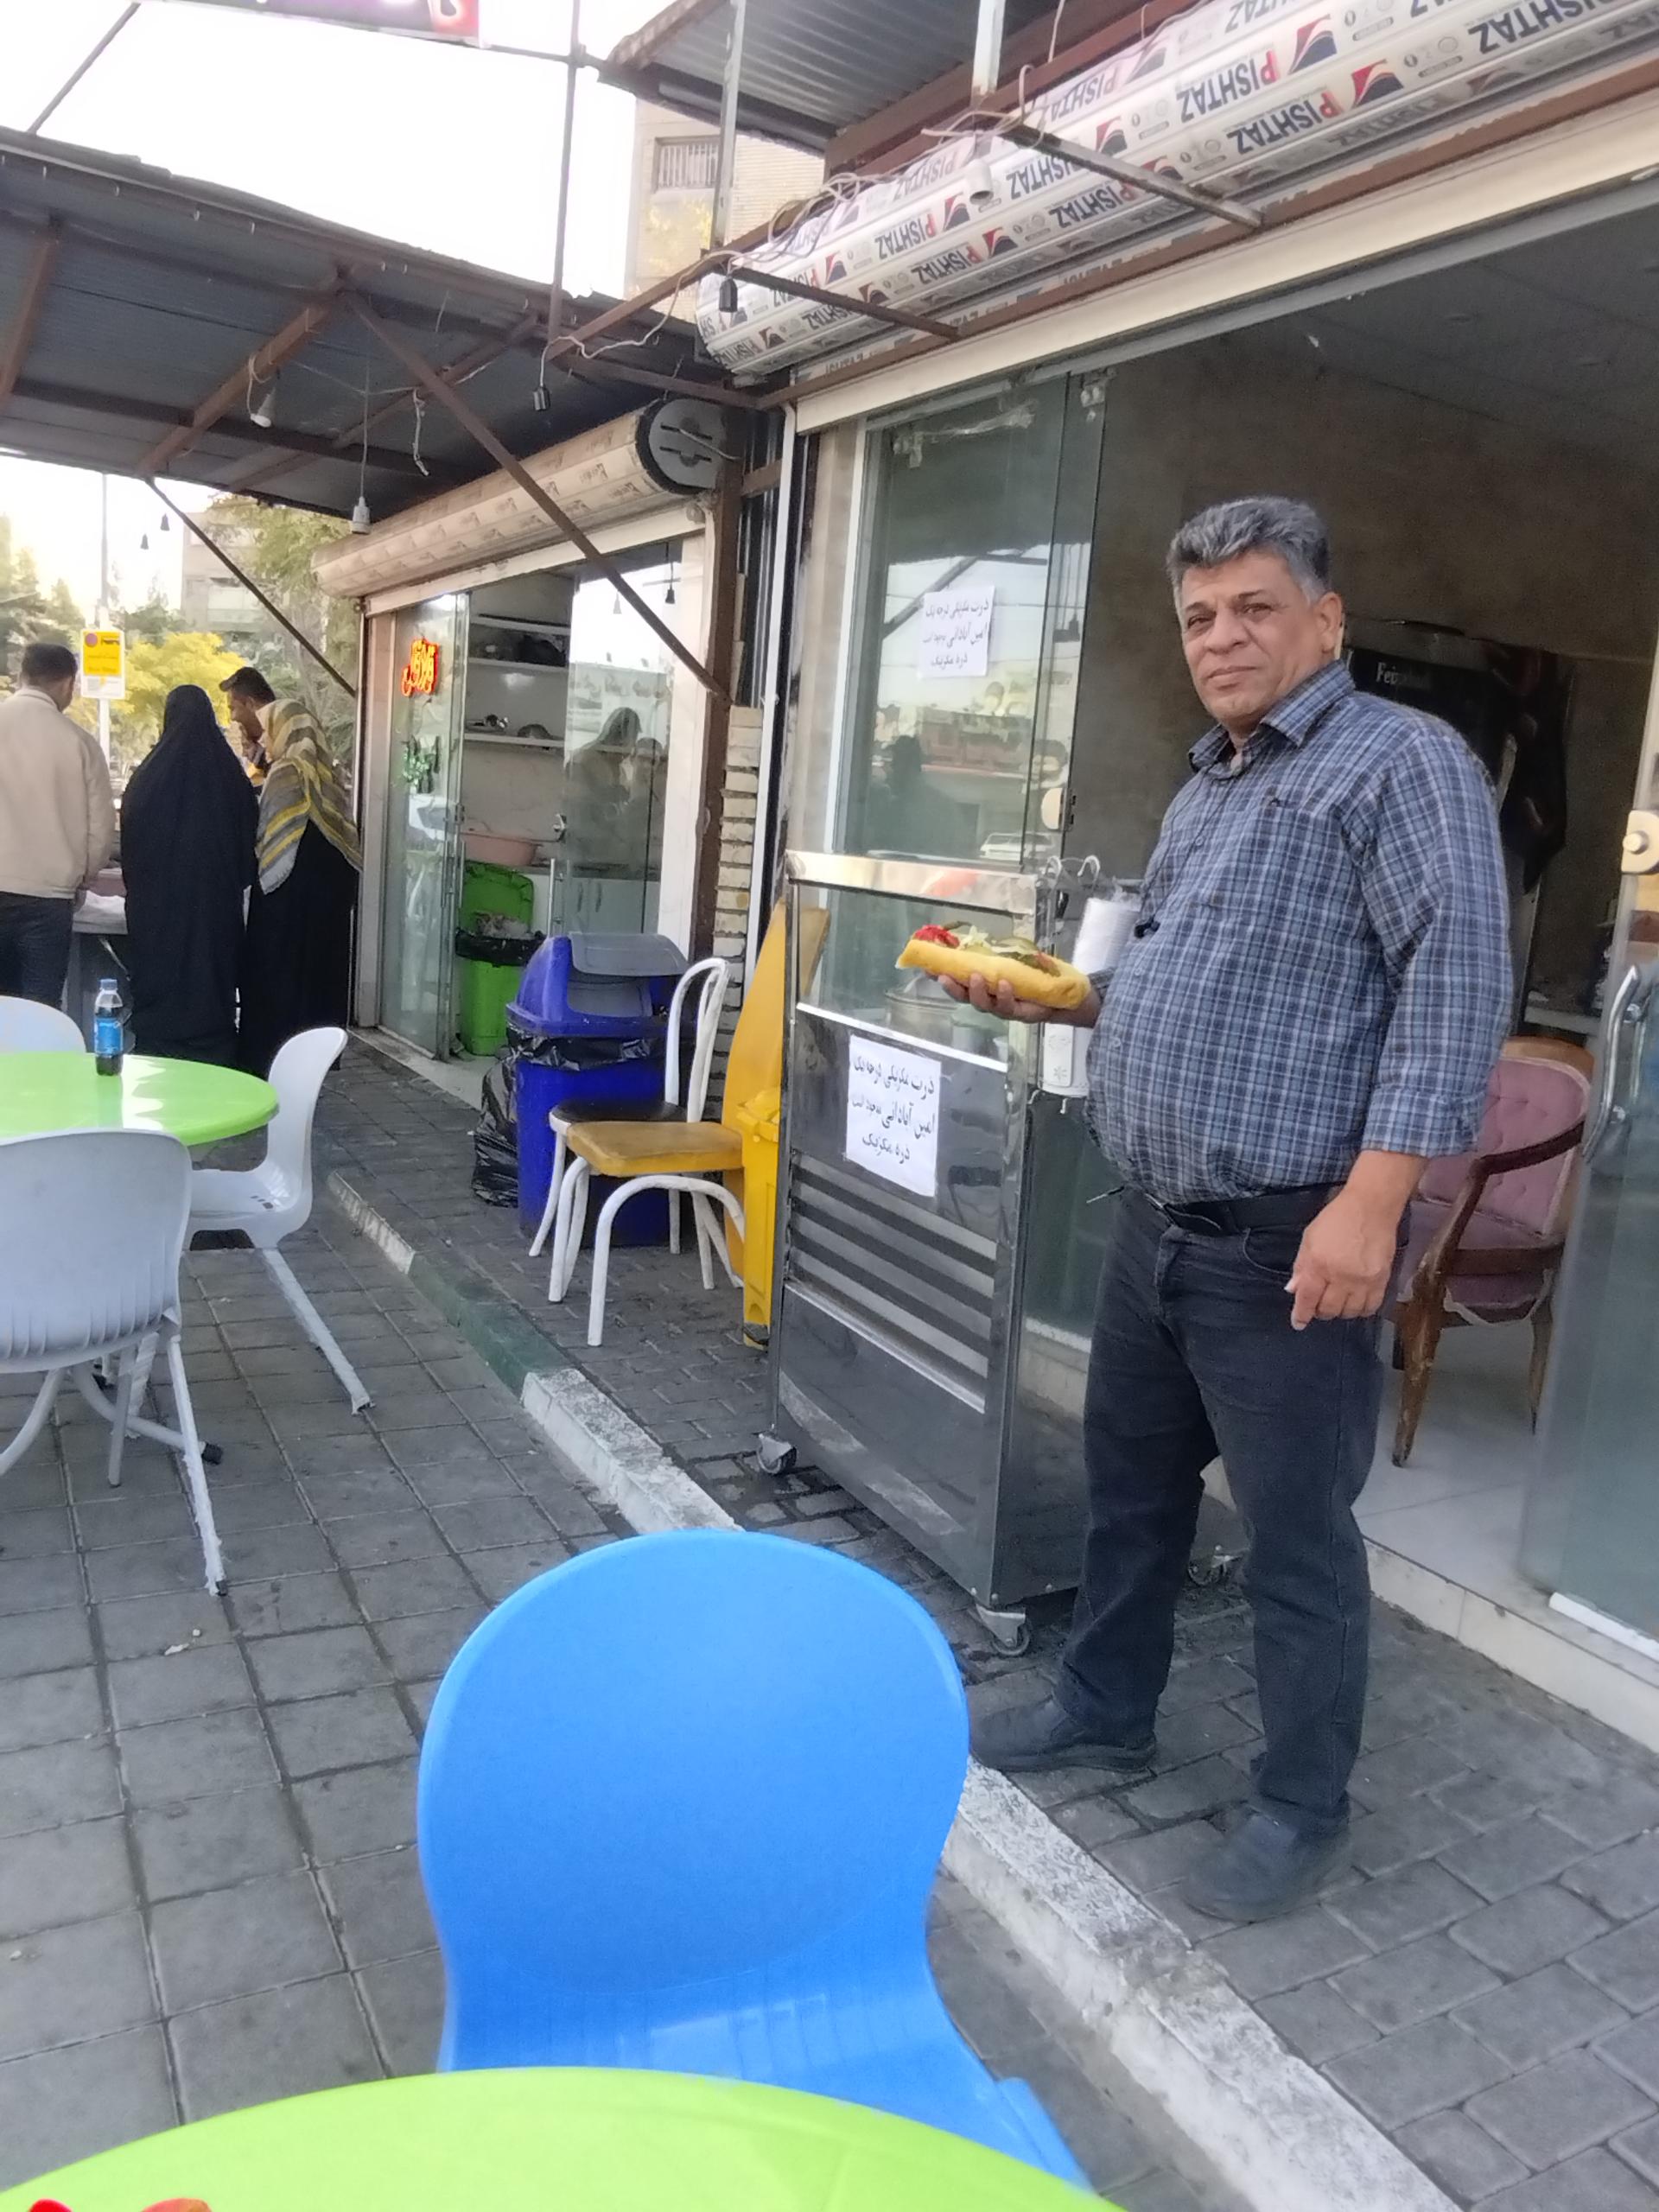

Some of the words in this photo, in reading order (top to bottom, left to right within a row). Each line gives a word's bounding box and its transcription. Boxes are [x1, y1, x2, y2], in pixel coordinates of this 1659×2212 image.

[1176, 49, 1279, 124] PISHTAZ
[1226, 90, 1343, 155] PISHTAZ
[874, 213, 937, 260] PISHTAZ
[910, 245, 983, 285] PISHTAZ
